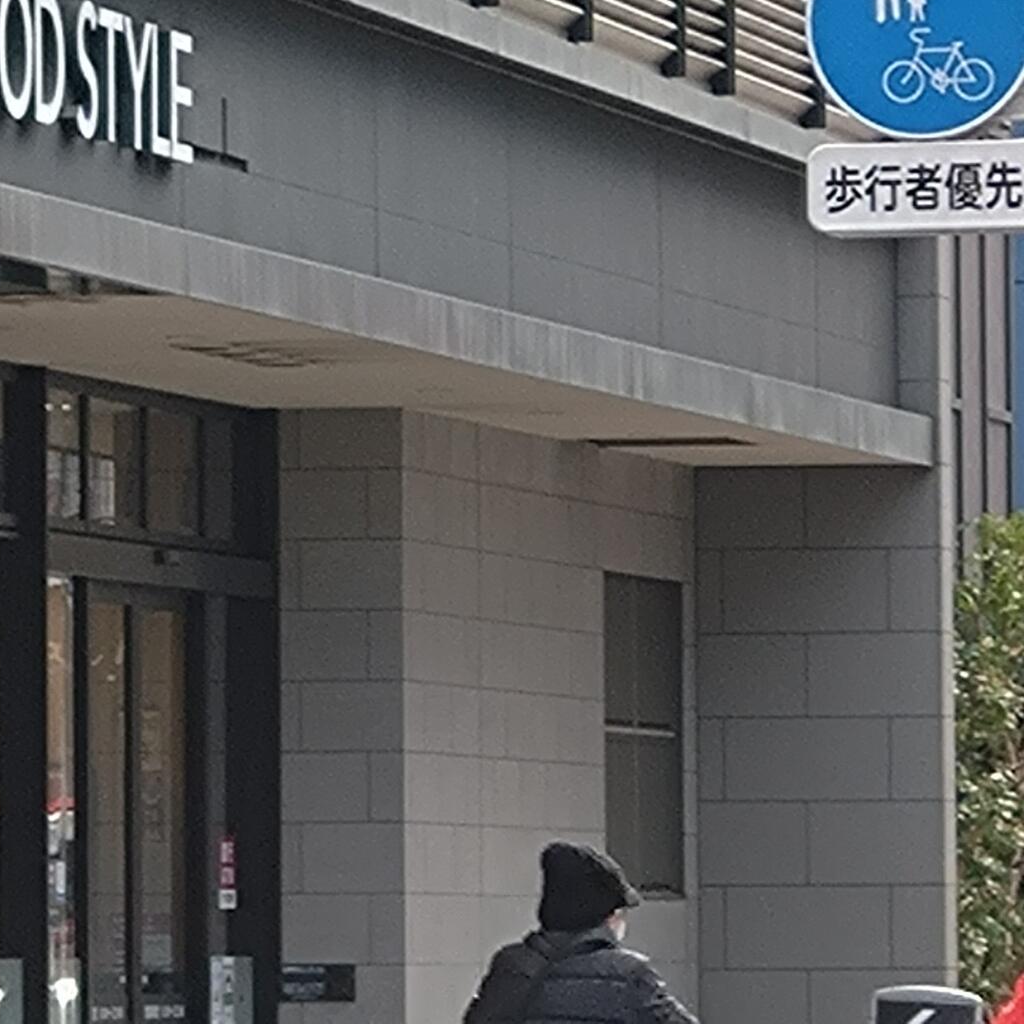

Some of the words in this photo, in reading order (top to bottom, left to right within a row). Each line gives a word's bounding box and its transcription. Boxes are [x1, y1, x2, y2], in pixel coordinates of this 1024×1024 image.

[76, 0, 193, 164] STYLE
[825, 161, 1022, 214] 歩行者優先
